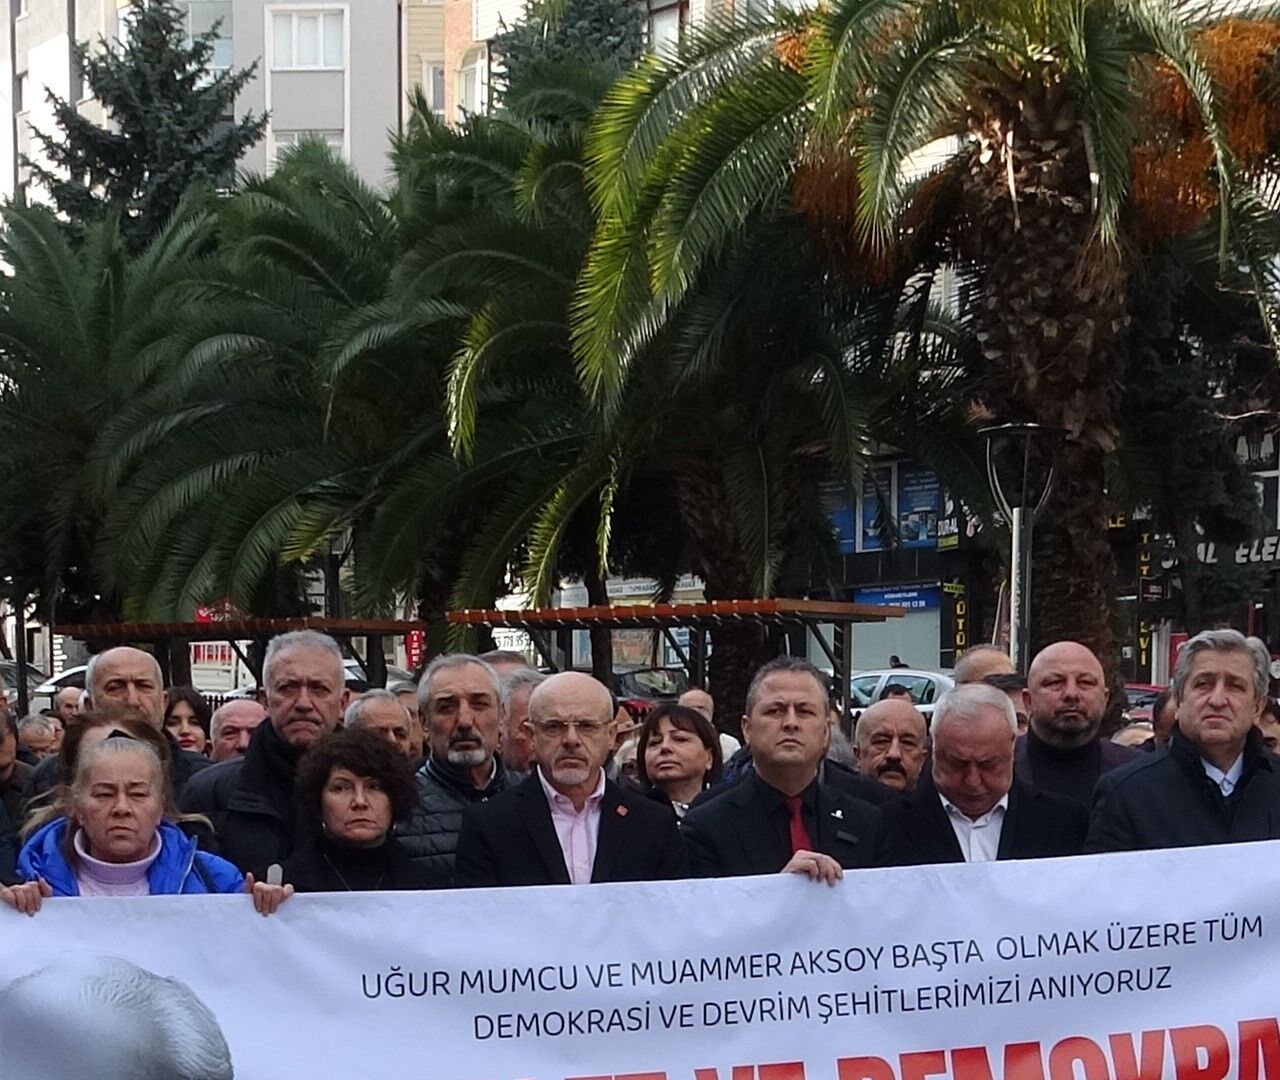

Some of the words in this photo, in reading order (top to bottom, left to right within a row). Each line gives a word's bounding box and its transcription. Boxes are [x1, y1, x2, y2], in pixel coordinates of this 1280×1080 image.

[361, 966, 450, 999] UĞUR
[460, 965, 578, 995] MUMCU
[586, 963, 623, 988] VE
[631, 953, 783, 986] MUAMMER
[790, 946, 885, 976] AKSOY
[893, 938, 984, 972] BAŞTA
[996, 928, 1100, 960] OLMAK
[1106, 918, 1197, 951] ÜZERE
[1204, 912, 1263, 942] TÜM
[474, 1001, 651, 1040] DEMOKRASİ
[659, 1004, 694, 1029] VE
[702, 990, 810, 1026] DEVRİM
[817, 973, 1021, 1025] ŞEHİTLERİMİZİ
[1028, 966, 1173, 1002] ANIYORUZ
